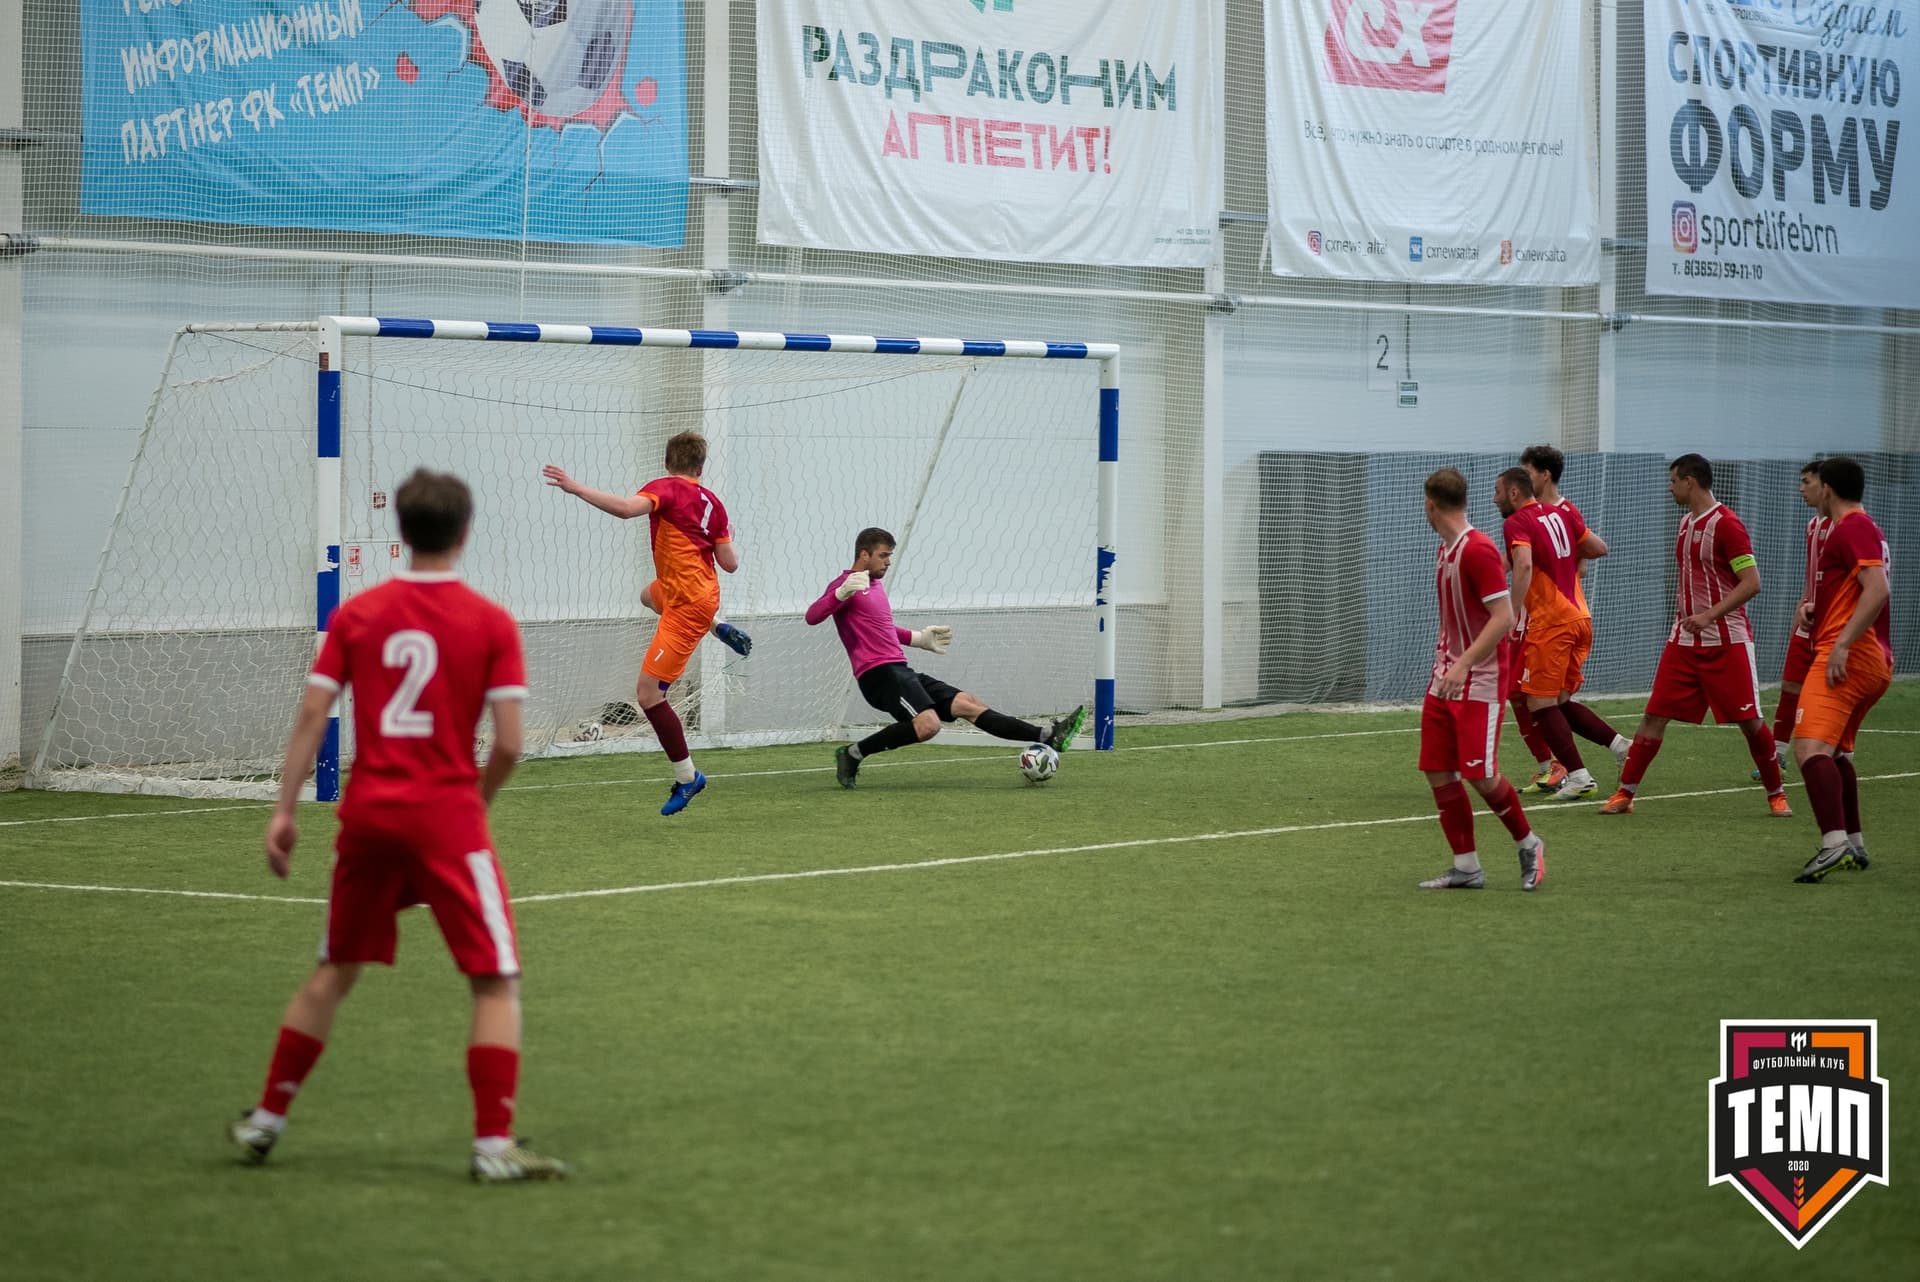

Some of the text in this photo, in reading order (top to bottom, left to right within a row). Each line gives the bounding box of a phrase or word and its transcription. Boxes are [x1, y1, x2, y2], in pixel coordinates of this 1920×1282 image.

[802, 24, 1177, 111] РАЗДРАКОНИМ
[1668, 31, 1900, 108] СПОРТИВНУЮ
[121, 62, 381, 165] ПАРТНЕР ФК «ТЕМП»
[881, 109, 1112, 174] АППЕТИТ!
[1384, 132, 1414, 148] знать
[1416, 135, 1424, 148] о
[1425, 135, 1465, 155] спорте
[1465, 138, 1473, 152] в
[1475, 140, 1519, 157] родном
[1669, 99, 1900, 211] ФОРМУ
[1701, 209, 1839, 255] sportlifebrn
[1684, 259, 1722, 280] 8(3852)
[1724, 262, 1763, 281] 59-11-10
[1376, 334, 1389, 371] 2
[700, 493, 713, 530] 7
[1538, 511, 1571, 560] 10
[654, 648, 665, 662] 7
[380, 629, 439, 738] 2
